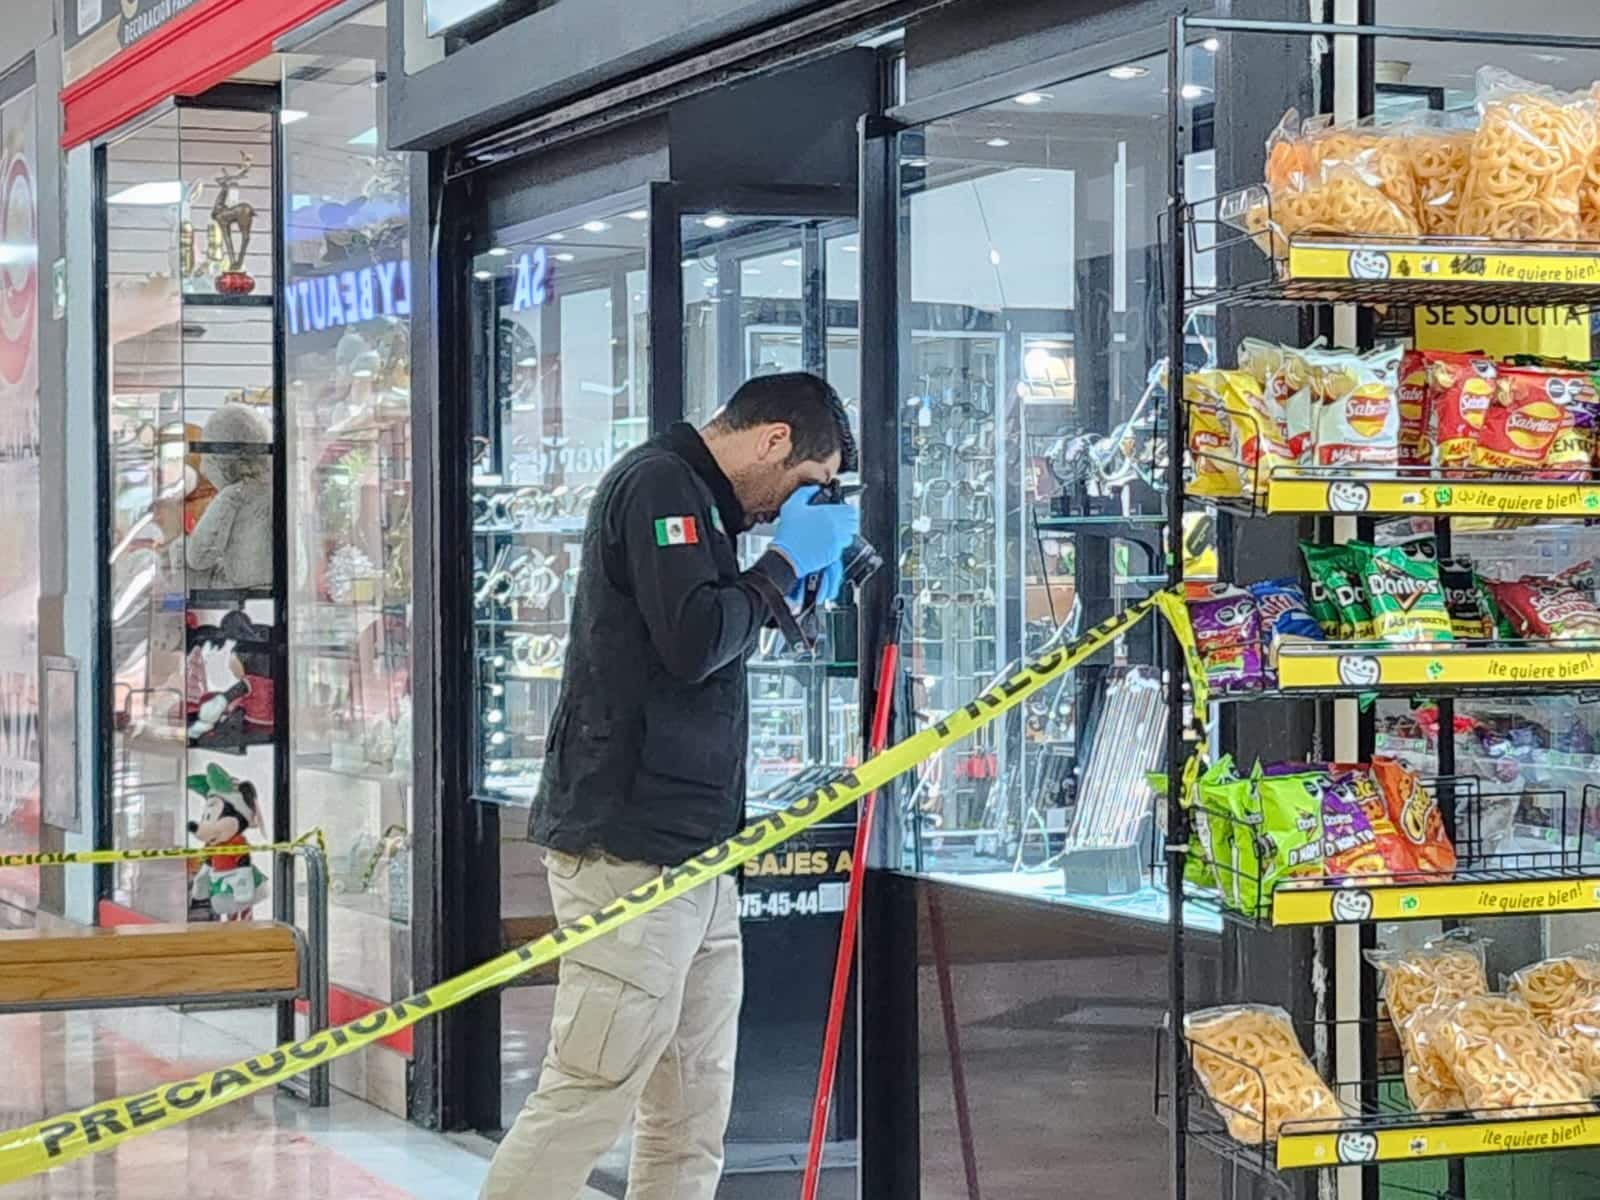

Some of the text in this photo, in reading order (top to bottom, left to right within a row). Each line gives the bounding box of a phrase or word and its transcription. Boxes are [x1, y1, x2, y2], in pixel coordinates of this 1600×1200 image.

[1518, 264, 1561, 281] quiere
[1424, 303, 1583, 326] SE SOLICITA
[1497, 494, 1543, 511] quiere
[1546, 485, 1582, 510] bien!
[1367, 573, 1439, 595] Doritos
[1510, 663, 1557, 681] quiere
[1559, 652, 1595, 678] bien!
[743, 851, 829, 877] SAJES
[1499, 894, 1545, 912] quiere
[1547, 882, 1584, 907] bien!
[1503, 1130, 1549, 1151] quiere
[1552, 1116, 1588, 1146] bien!
